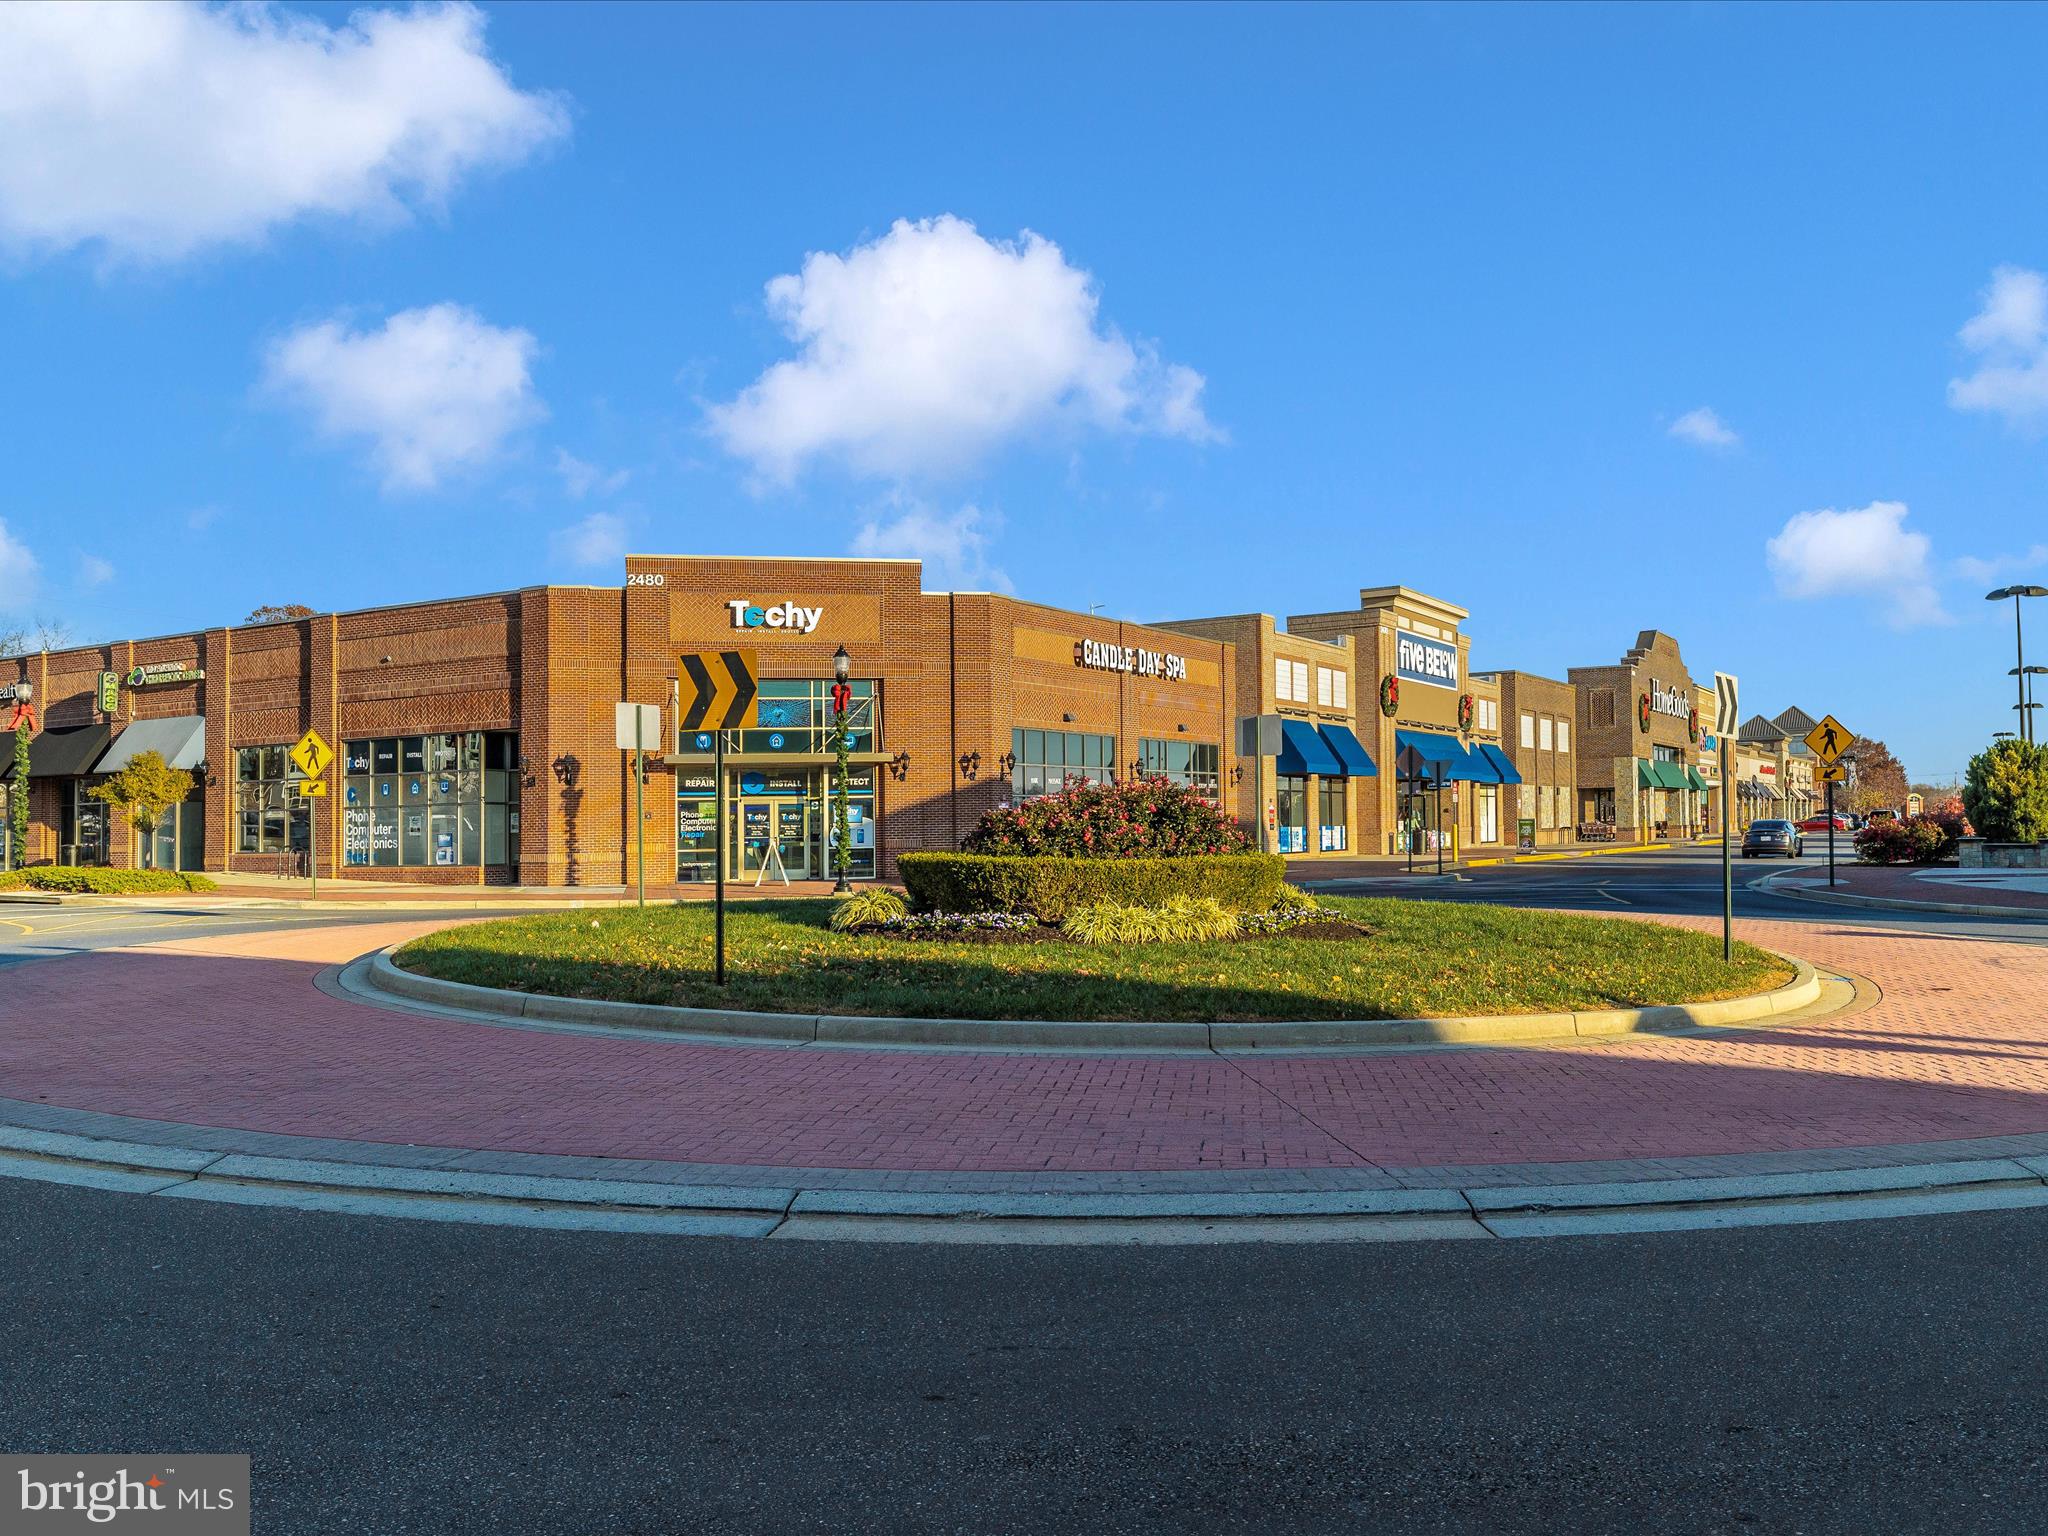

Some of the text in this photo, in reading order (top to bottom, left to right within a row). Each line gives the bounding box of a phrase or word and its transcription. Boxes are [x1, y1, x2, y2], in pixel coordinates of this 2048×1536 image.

[627, 574, 664, 586] 2480
[729, 600, 824, 632] Techy
[1083, 638, 1187, 680] CANDLE DAY SPA
[1399, 639, 1457, 680] five BELOW
[1651, 678, 1689, 720] HomeGoods
[346, 756, 370, 770] Techy
[346, 837, 398, 849] Electonics
[680, 831, 705, 839] Repair
